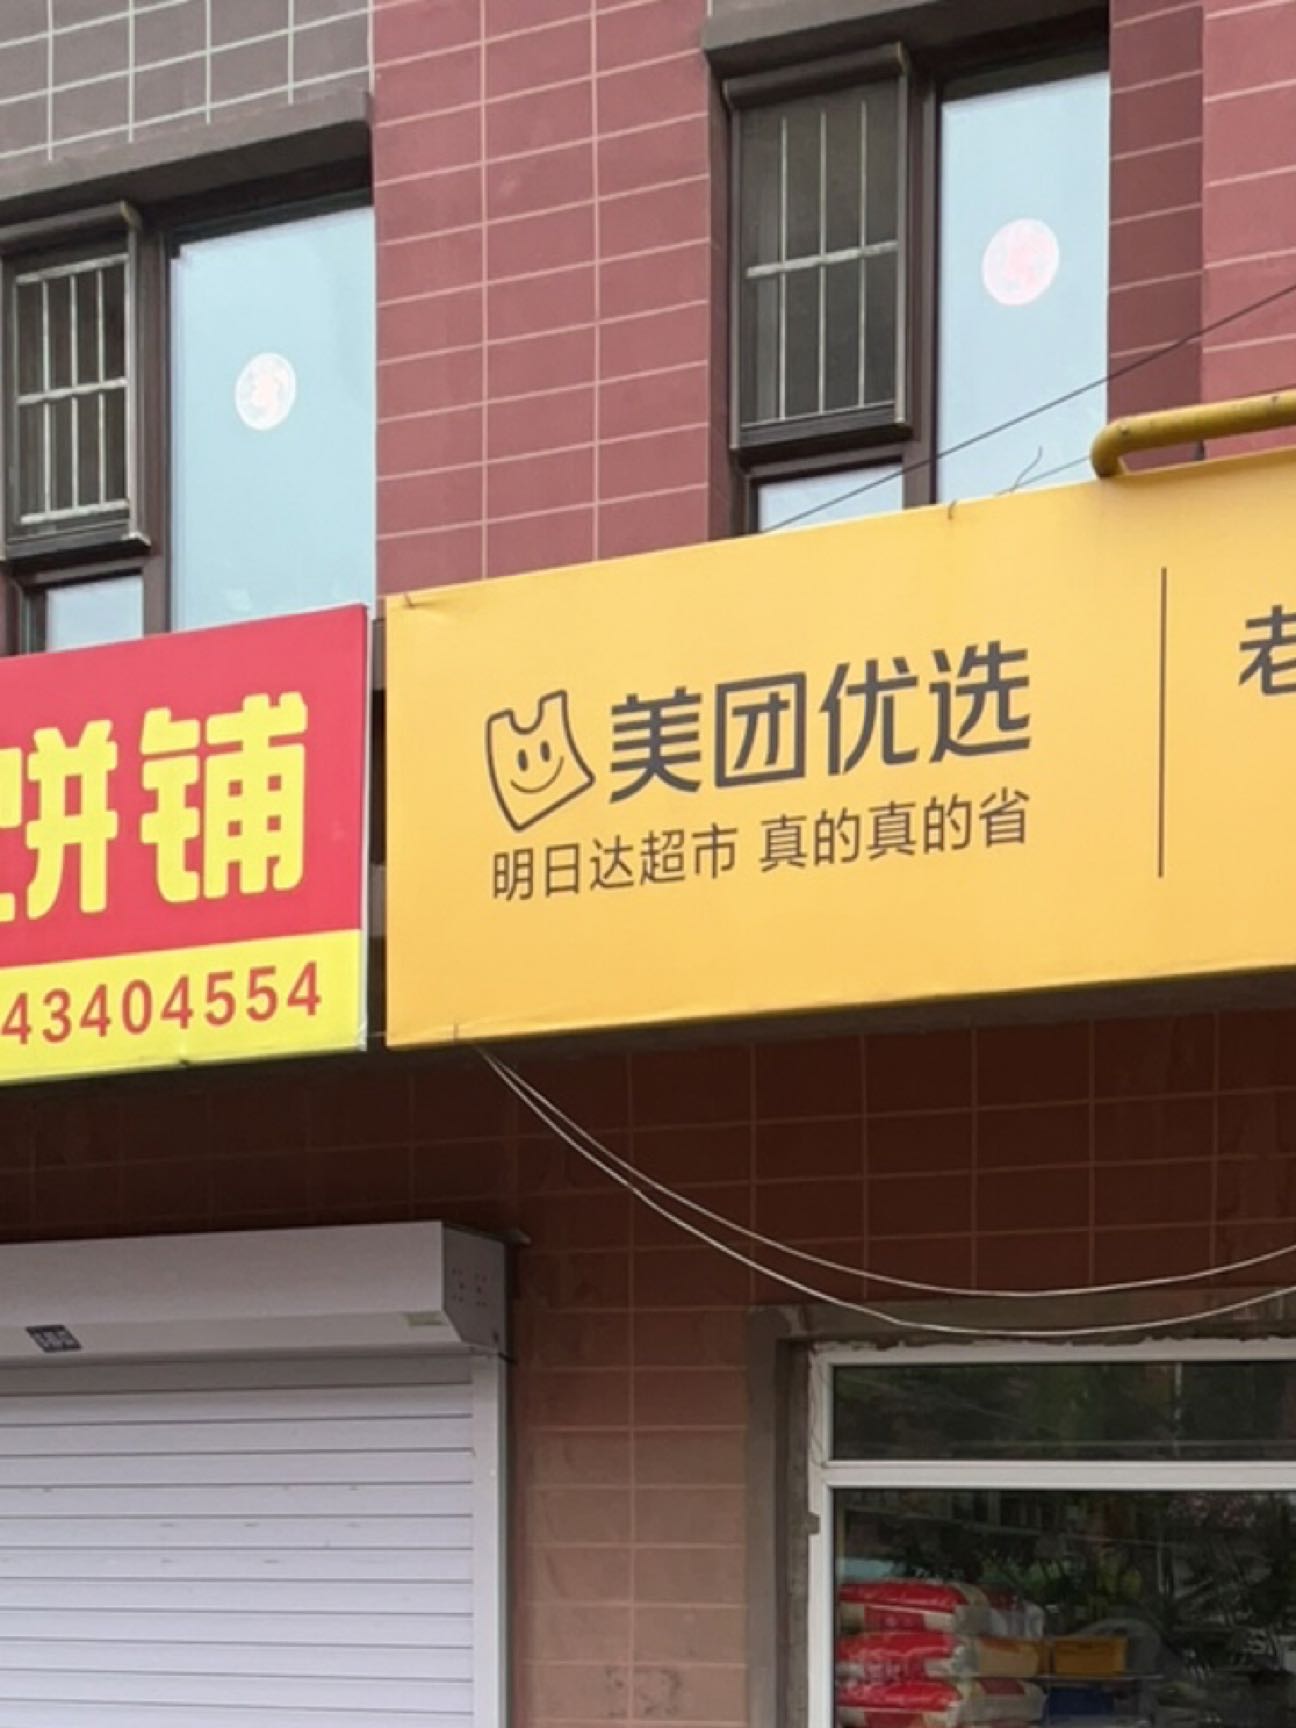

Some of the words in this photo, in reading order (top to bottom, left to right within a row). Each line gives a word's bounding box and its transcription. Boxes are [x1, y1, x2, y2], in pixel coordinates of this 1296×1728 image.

[608, 639, 1031, 804] 美团优选
[491, 821, 738, 902] 明日达超市
[758, 786, 1031, 873] 真的真的省
[1, 959, 322, 1046] 43404554
